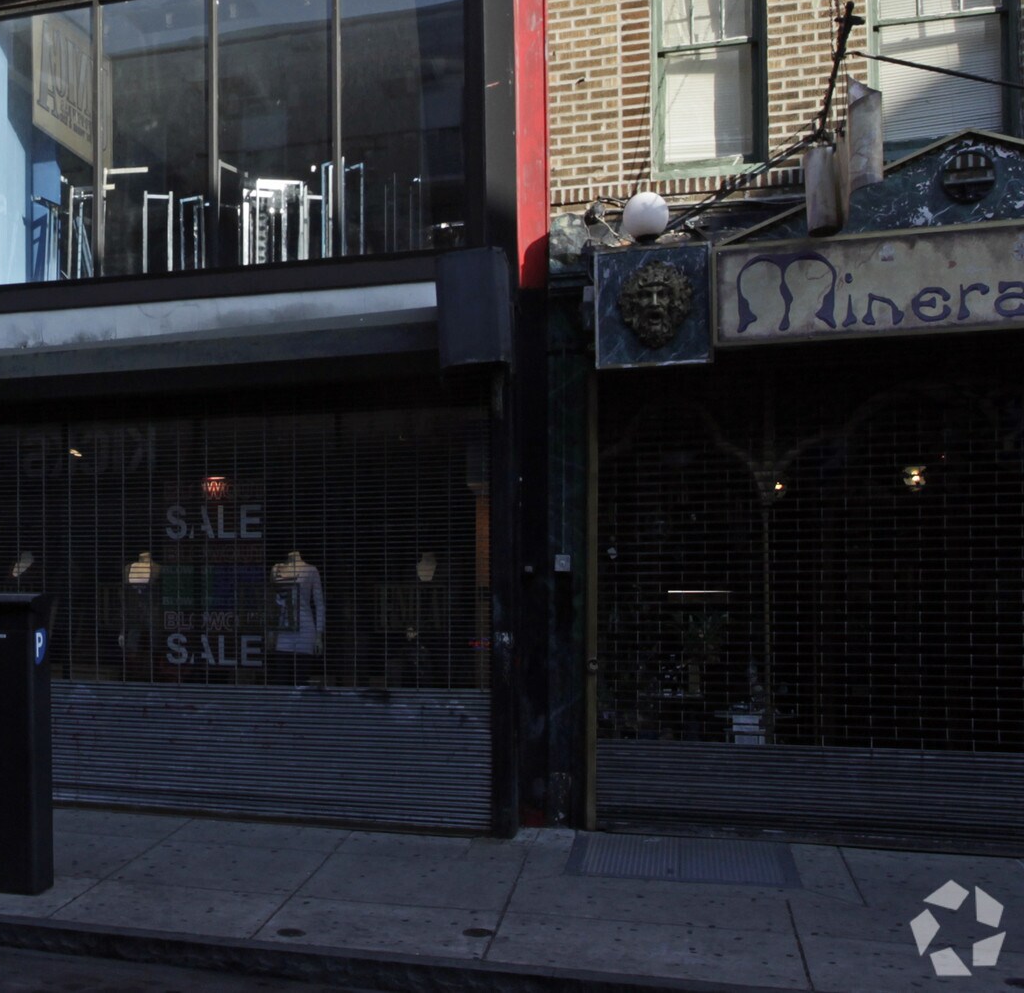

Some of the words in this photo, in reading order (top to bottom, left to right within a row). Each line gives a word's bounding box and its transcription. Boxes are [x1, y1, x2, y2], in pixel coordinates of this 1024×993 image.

[165, 505, 263, 540] SALE
[36, 632, 43, 658] P
[166, 633, 263, 667] SALE
